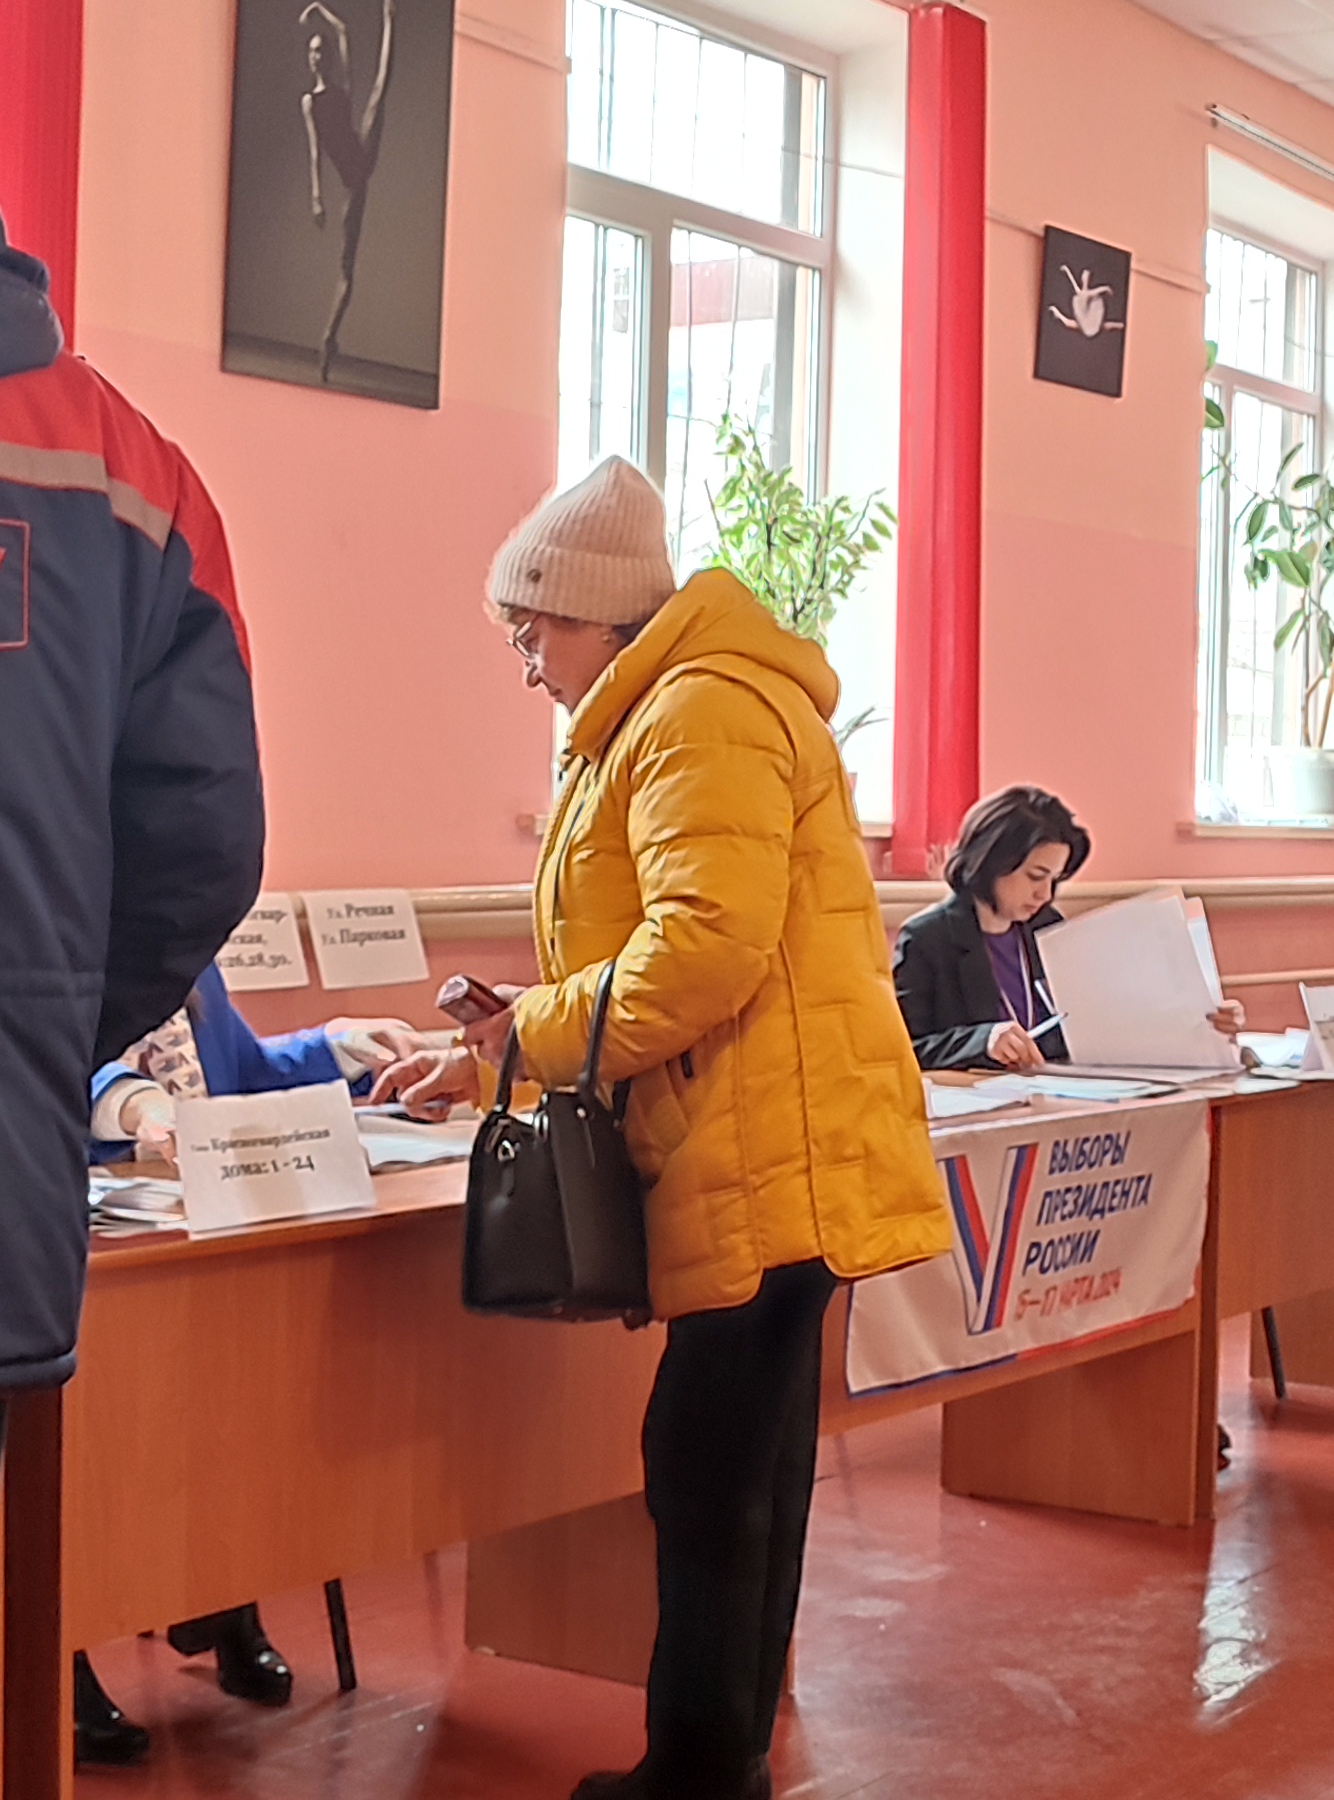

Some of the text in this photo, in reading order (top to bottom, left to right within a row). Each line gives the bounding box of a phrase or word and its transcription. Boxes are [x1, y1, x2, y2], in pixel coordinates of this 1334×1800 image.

[1047, 1131, 1132, 1176] ВЫБОРЫ
[1035, 1173, 1153, 1227] ПРЕЗИДЕНТА
[1021, 1228, 1102, 1277] РОССИИ
